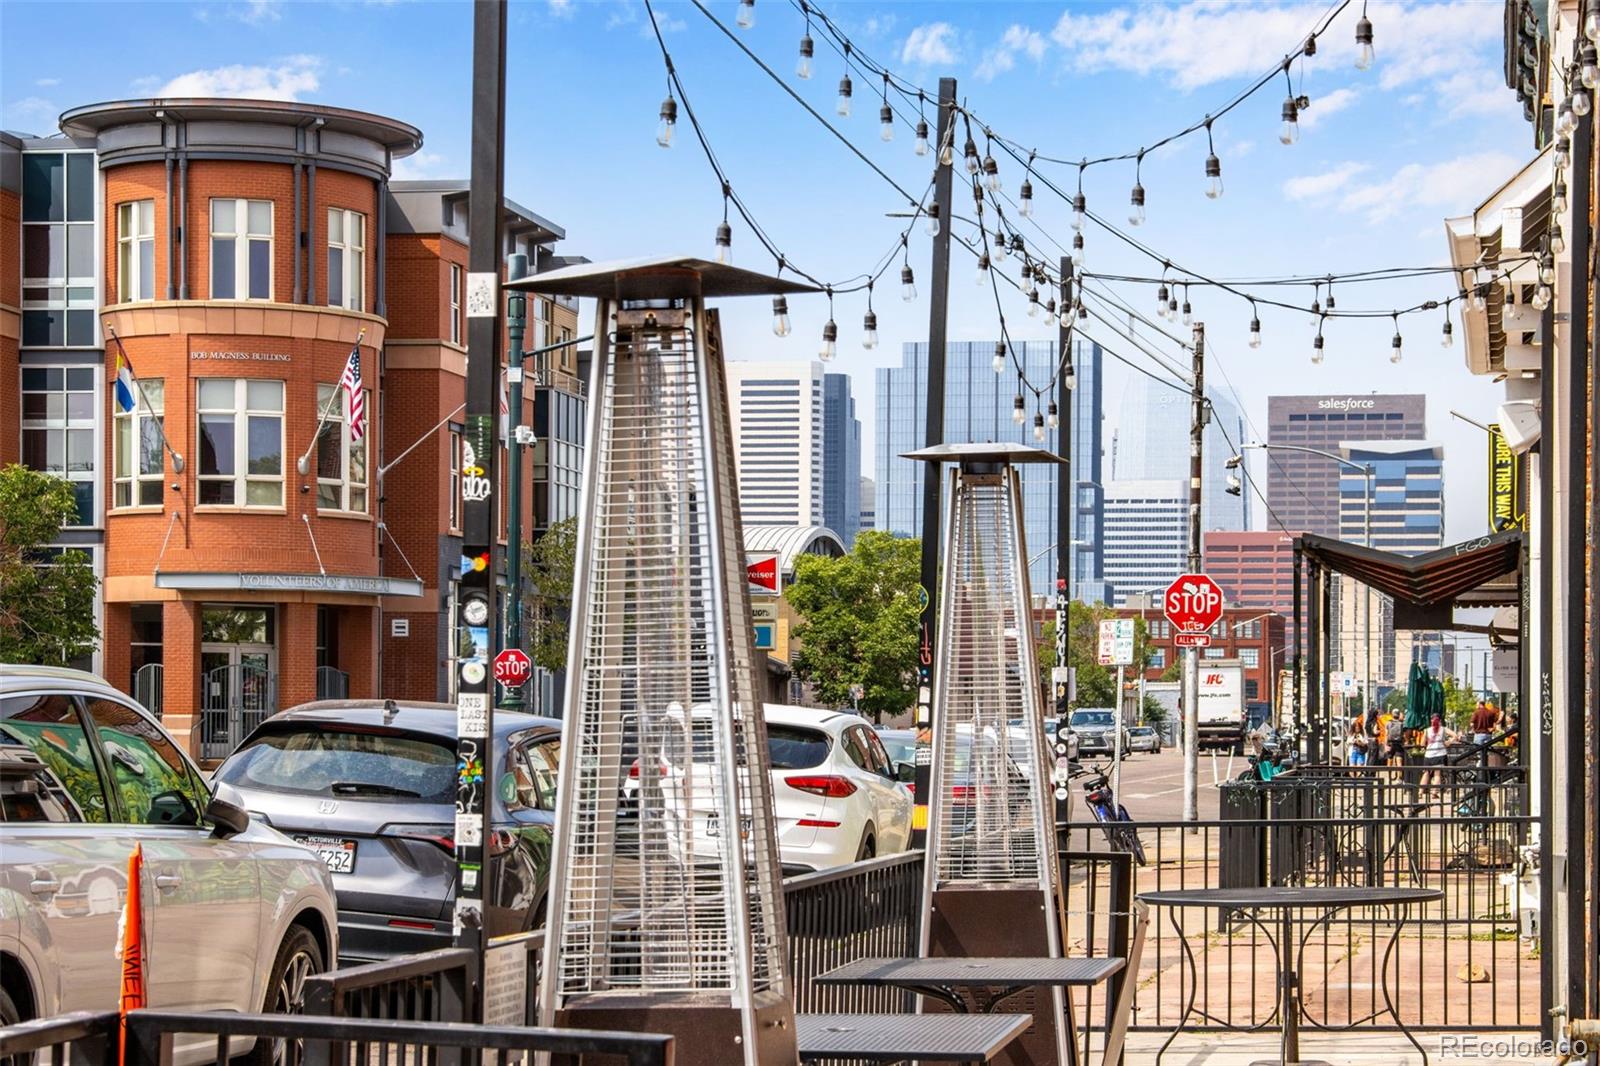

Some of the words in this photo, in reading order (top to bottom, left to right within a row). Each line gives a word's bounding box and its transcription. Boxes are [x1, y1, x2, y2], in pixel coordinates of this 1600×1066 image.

[191, 351, 208, 360] BOB
[209, 351, 250, 360] MAGNESS
[252, 352, 291, 362] BUILDING
[1318, 397, 1375, 412] salesforce
[1496, 466, 1512, 493] THIS
[1496, 494, 1512, 520] WAY
[241, 574, 323, 589] VOLUNTEERS
[326, 576, 338, 589] OF
[345, 577, 389, 592] AMERICA
[1168, 592, 1219, 614] STOP
[496, 661, 528, 676] STOP
[317, 849, 350, 868] 252
